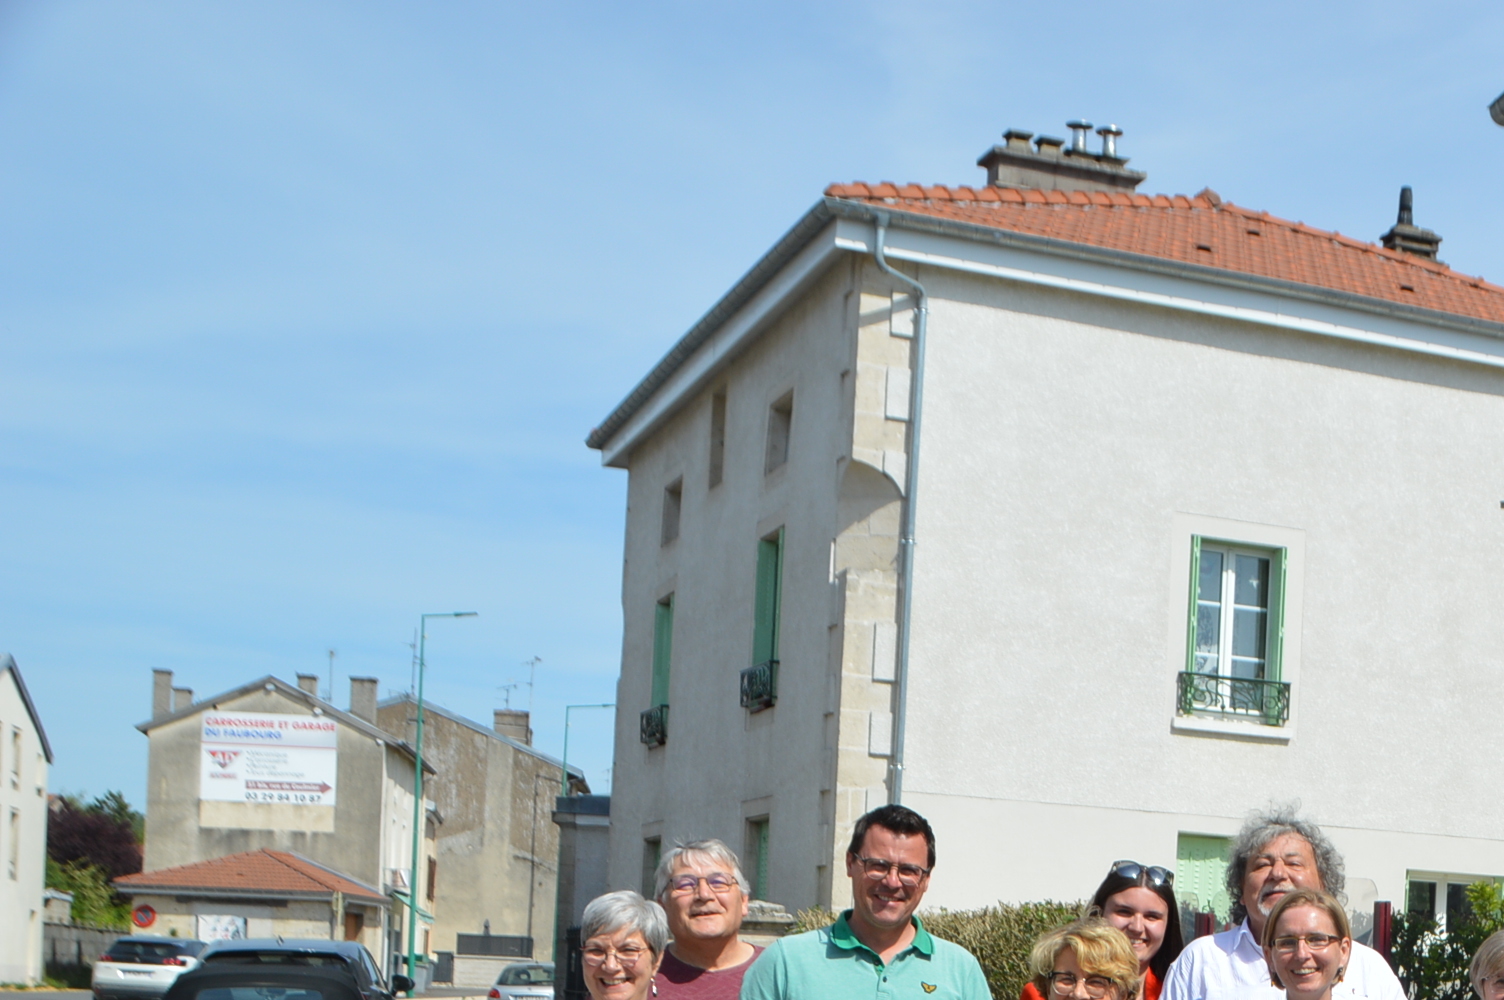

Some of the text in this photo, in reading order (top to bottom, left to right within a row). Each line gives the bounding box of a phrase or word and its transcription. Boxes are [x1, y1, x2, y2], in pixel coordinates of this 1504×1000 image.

[205, 717, 335, 731] CARROSSERIE ET GARAGE
[204, 727, 282, 739] DU FAUBOURG
